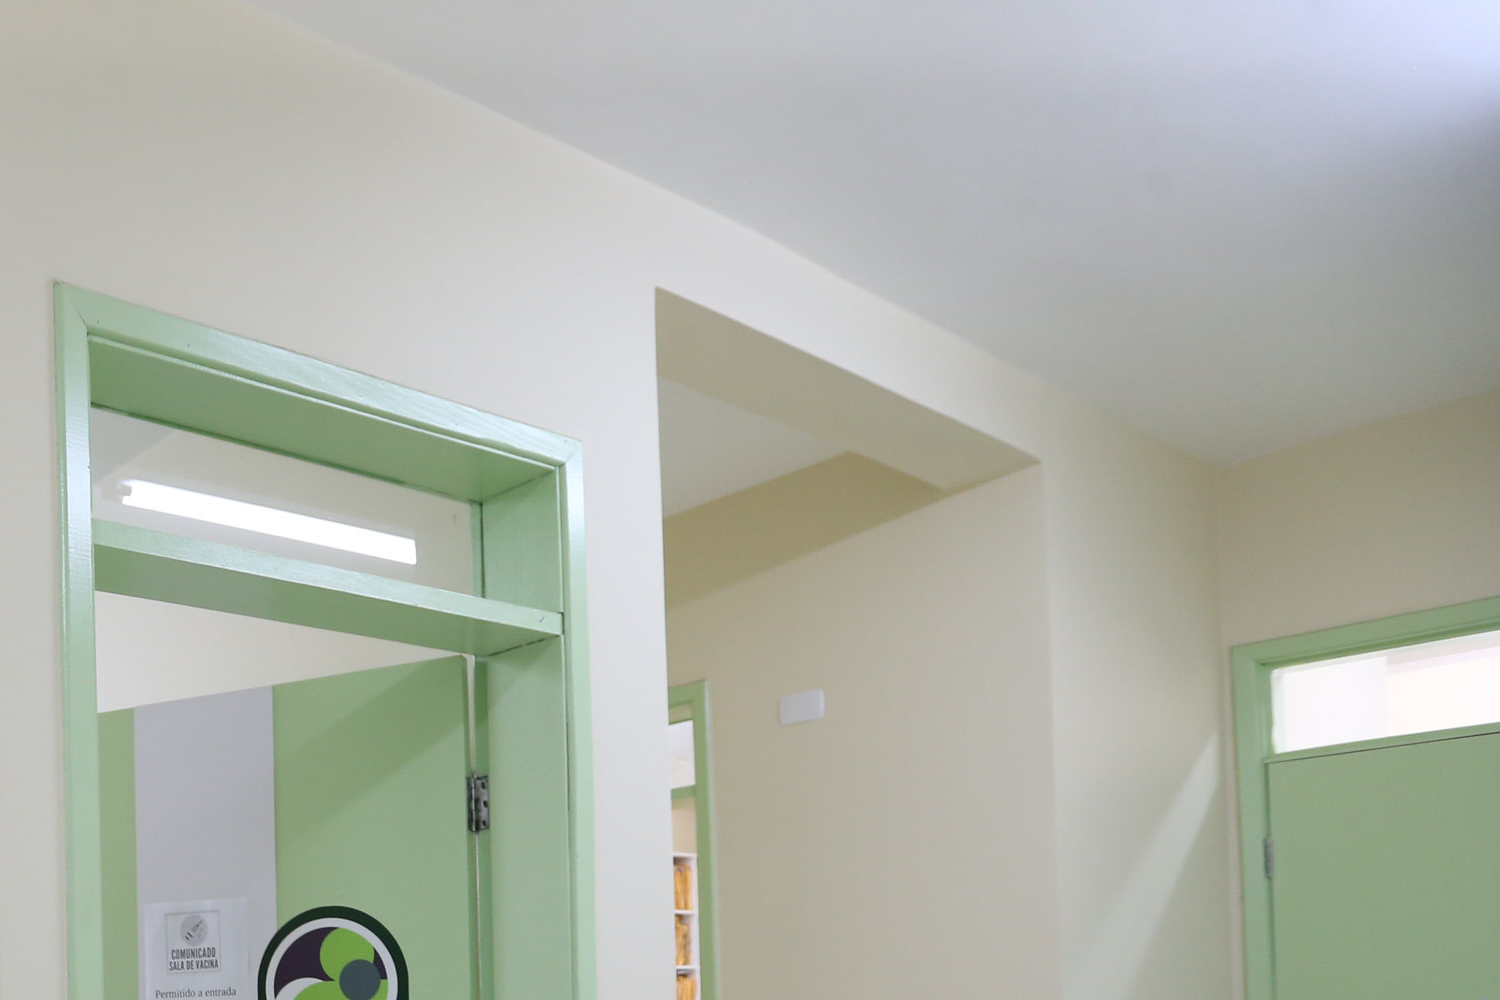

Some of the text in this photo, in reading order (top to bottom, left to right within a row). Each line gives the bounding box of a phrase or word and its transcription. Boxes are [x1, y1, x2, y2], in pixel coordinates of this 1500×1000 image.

[171, 947, 216, 960] COMUNICADO
[169, 959, 219, 971] SALA DE VACINA
[155, 987, 237, 999] Permitido a entrada
